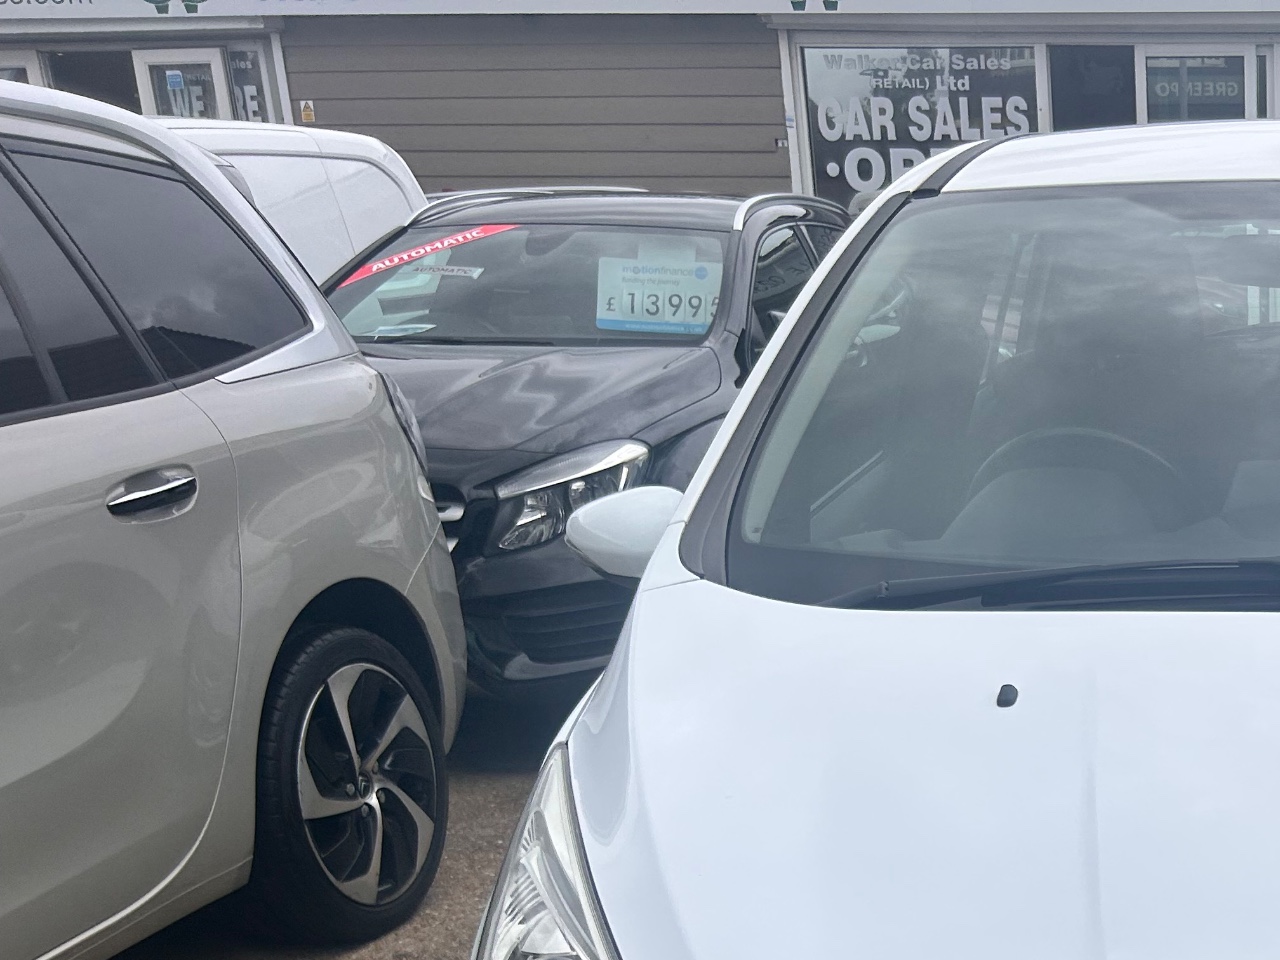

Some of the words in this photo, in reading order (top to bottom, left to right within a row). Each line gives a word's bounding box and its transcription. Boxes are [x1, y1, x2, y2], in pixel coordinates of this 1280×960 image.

[906, 54, 943, 71] Car
[951, 54, 1012, 71] Sales
[870, 77, 930, 90] (RETAIL)
[937, 75, 970, 92] Ltd
[817, 96, 898, 142] CAR
[908, 95, 1030, 142] SALES
[844, 147, 953, 193] OP
[371, 229, 486, 272] AUTOMATIC
[412, 266, 473, 276] AUTOMATIC
